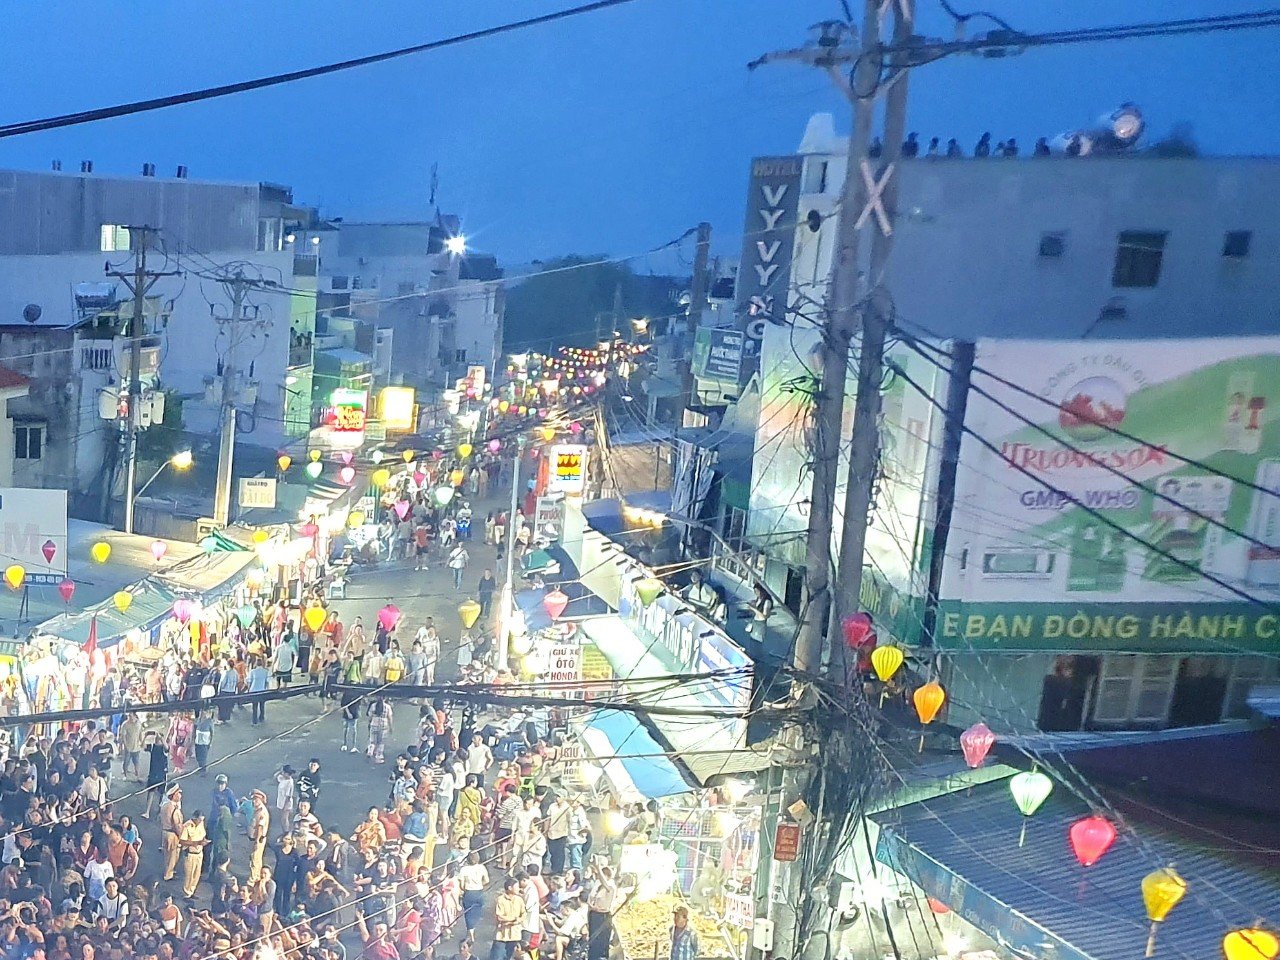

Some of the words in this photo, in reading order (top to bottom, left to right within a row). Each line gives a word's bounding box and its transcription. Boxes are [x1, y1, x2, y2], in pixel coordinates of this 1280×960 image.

[1084, 489, 1138, 507] WHO
[965, 614, 1032, 643] BẠN
[1150, 610, 1243, 639] HÀNH
[550, 671, 578, 681] HONDA
